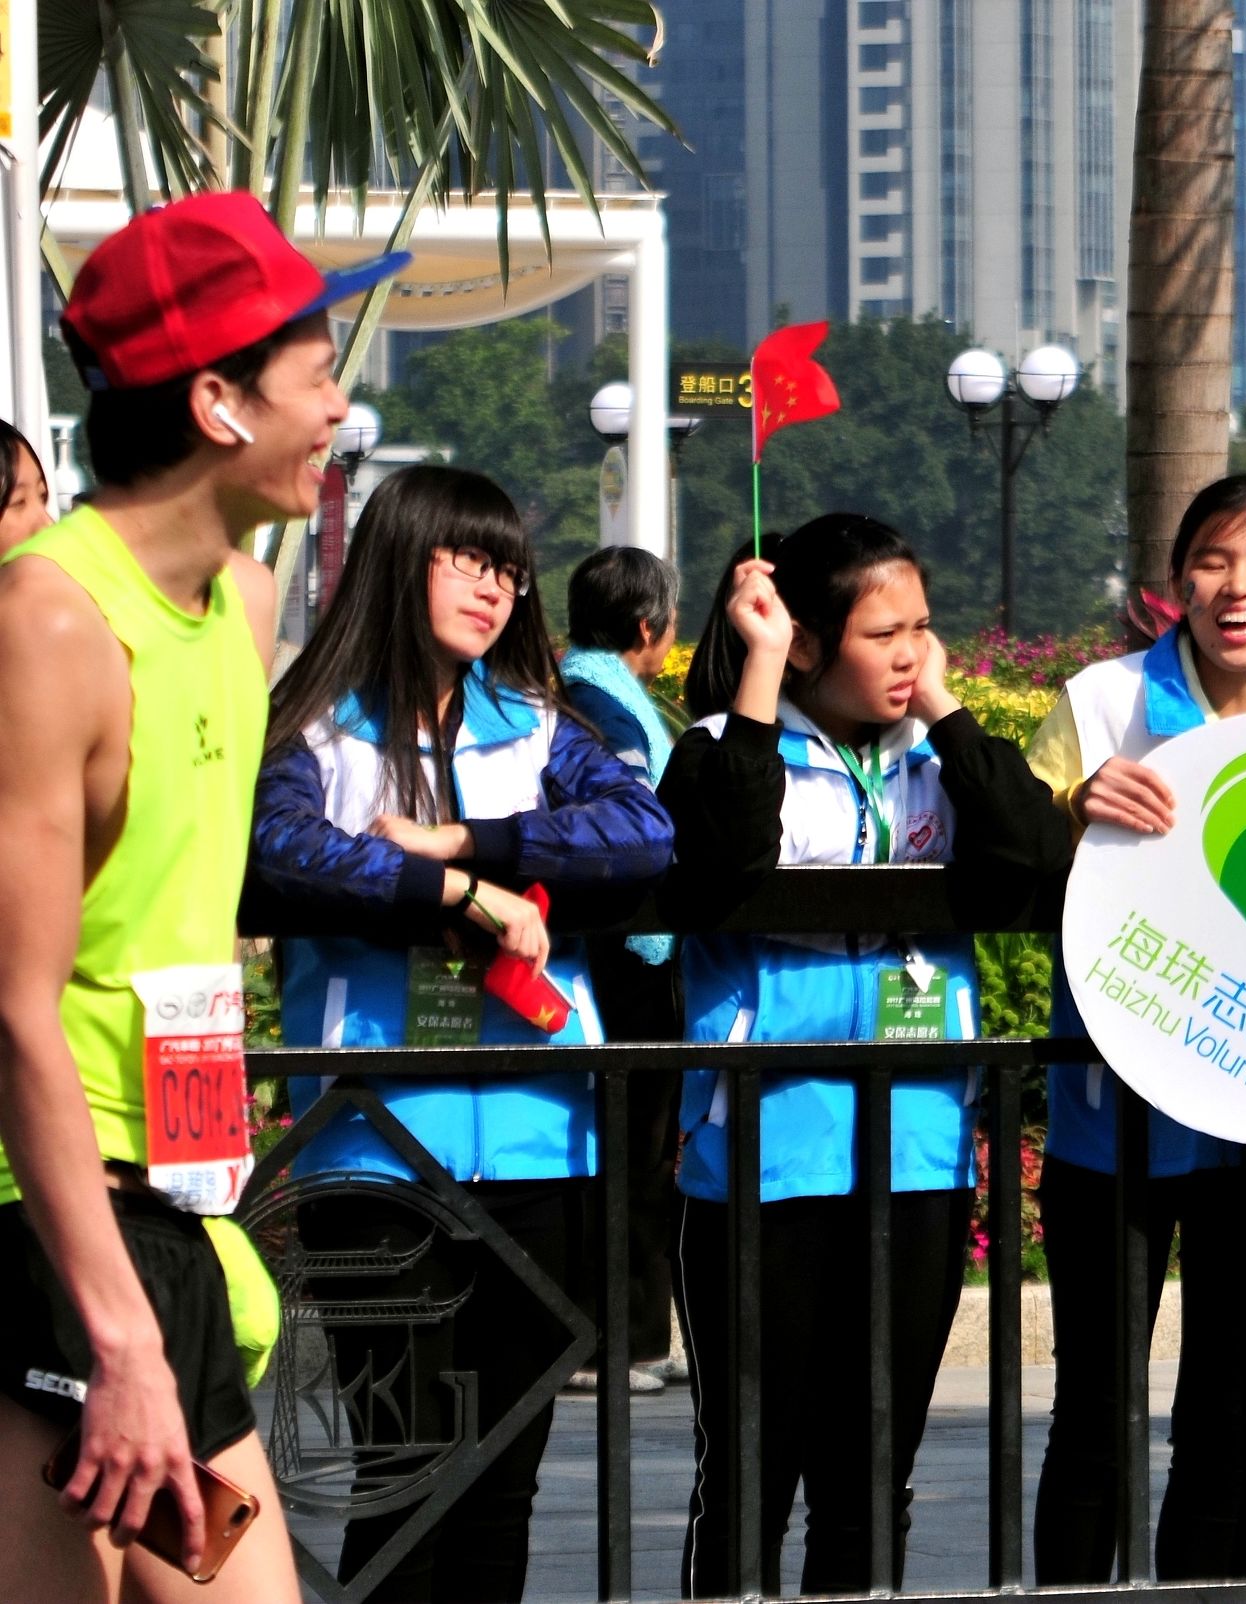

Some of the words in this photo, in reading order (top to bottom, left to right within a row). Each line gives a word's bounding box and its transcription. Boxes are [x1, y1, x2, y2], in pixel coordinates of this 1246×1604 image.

[679, 396, 713, 405] Boarding
[715, 397, 734, 405] Gate
[680, 375, 735, 393] 登船口
[738, 374, 753, 408] 3
[1085, 957, 1182, 1037] Haizhu
[884, 1026, 939, 1039] 安保志愿者
